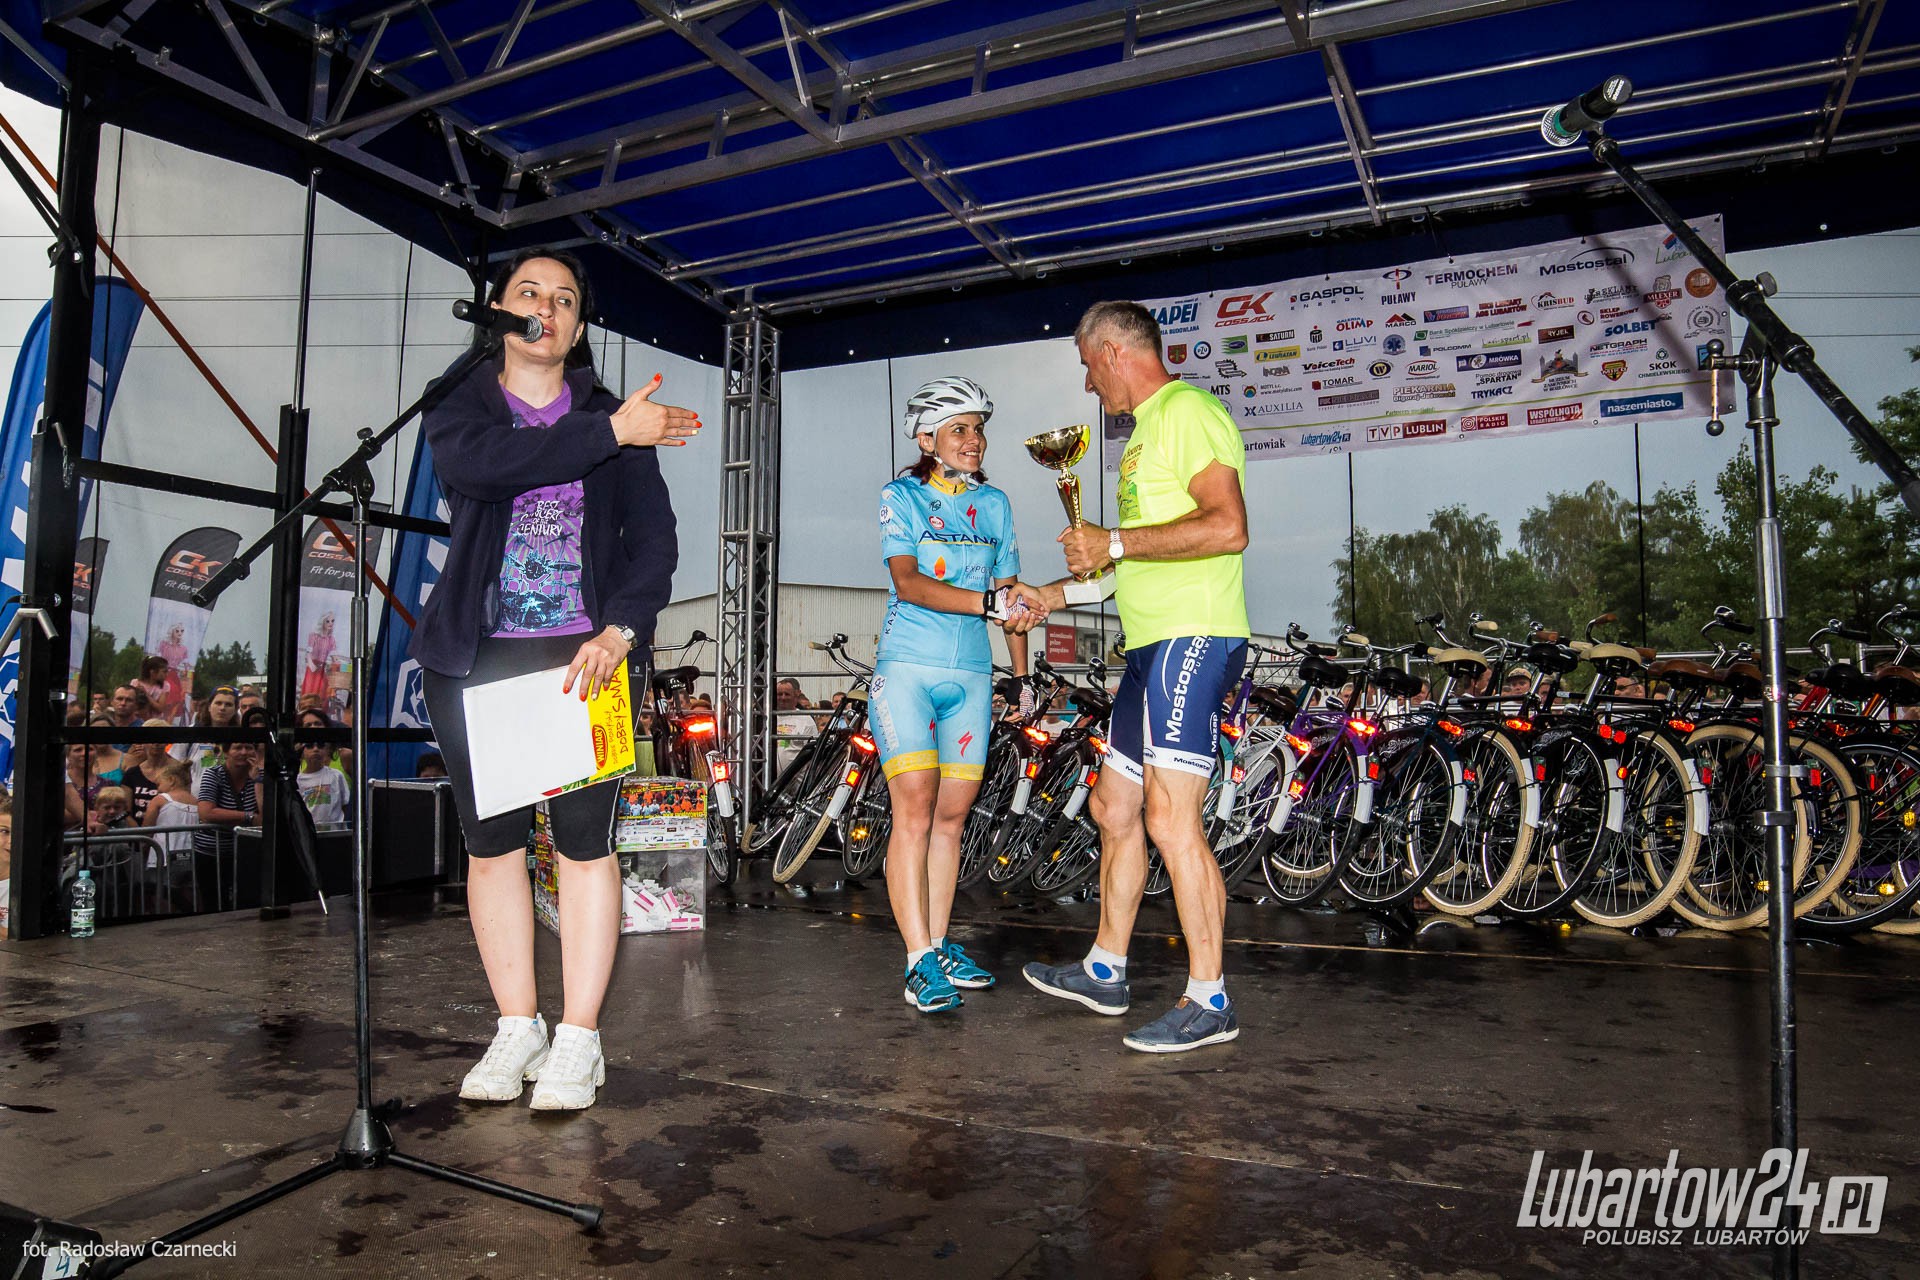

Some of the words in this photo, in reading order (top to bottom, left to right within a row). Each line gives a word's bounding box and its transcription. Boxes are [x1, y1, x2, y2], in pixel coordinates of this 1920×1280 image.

[1540, 253, 1627, 276] Mostostal
[1425, 263, 1518, 285] TERMOCHEM
[1300, 286, 1364, 302] GASPOL
[1381, 291, 1417, 306] PUŁAWY
[1214, 313, 1276, 328] COSSACK
[1336, 318, 1374, 332] OLIMP
[1385, 320, 1417, 328] MARCO
[1269, 330, 1294, 340] SATURN
[1605, 320, 1657, 337] SOLBET
[1345, 336, 1376, 347] LUVI
[1589, 338, 1648, 352] NETGRAPH
[1301, 357, 1355, 371] VoiceTech
[1408, 363, 1438, 373] MARIOL
[1649, 360, 1678, 371] SKOK
[1322, 376, 1354, 387] TOMAR
[1393, 383, 1456, 395] PIEKARNIA
[1471, 385, 1513, 399] TRYKACZ
[1258, 401, 1304, 414] AUXILIA
[1529, 405, 1580, 419] WSPÓLNOTA
[1368, 426, 1401, 439] TVP
[1406, 424, 1444, 435] LUBLIN
[1244, 438, 1286, 451] artowiak
[517, 523, 563, 536] CENTURY
[919, 530, 998, 548] ASTANA
[308, 551, 356, 563] COSSA
[610, 665, 627, 713] SMA
[1165, 635, 1208, 743] Mostosta
[594, 726, 605, 763] WINIARY
